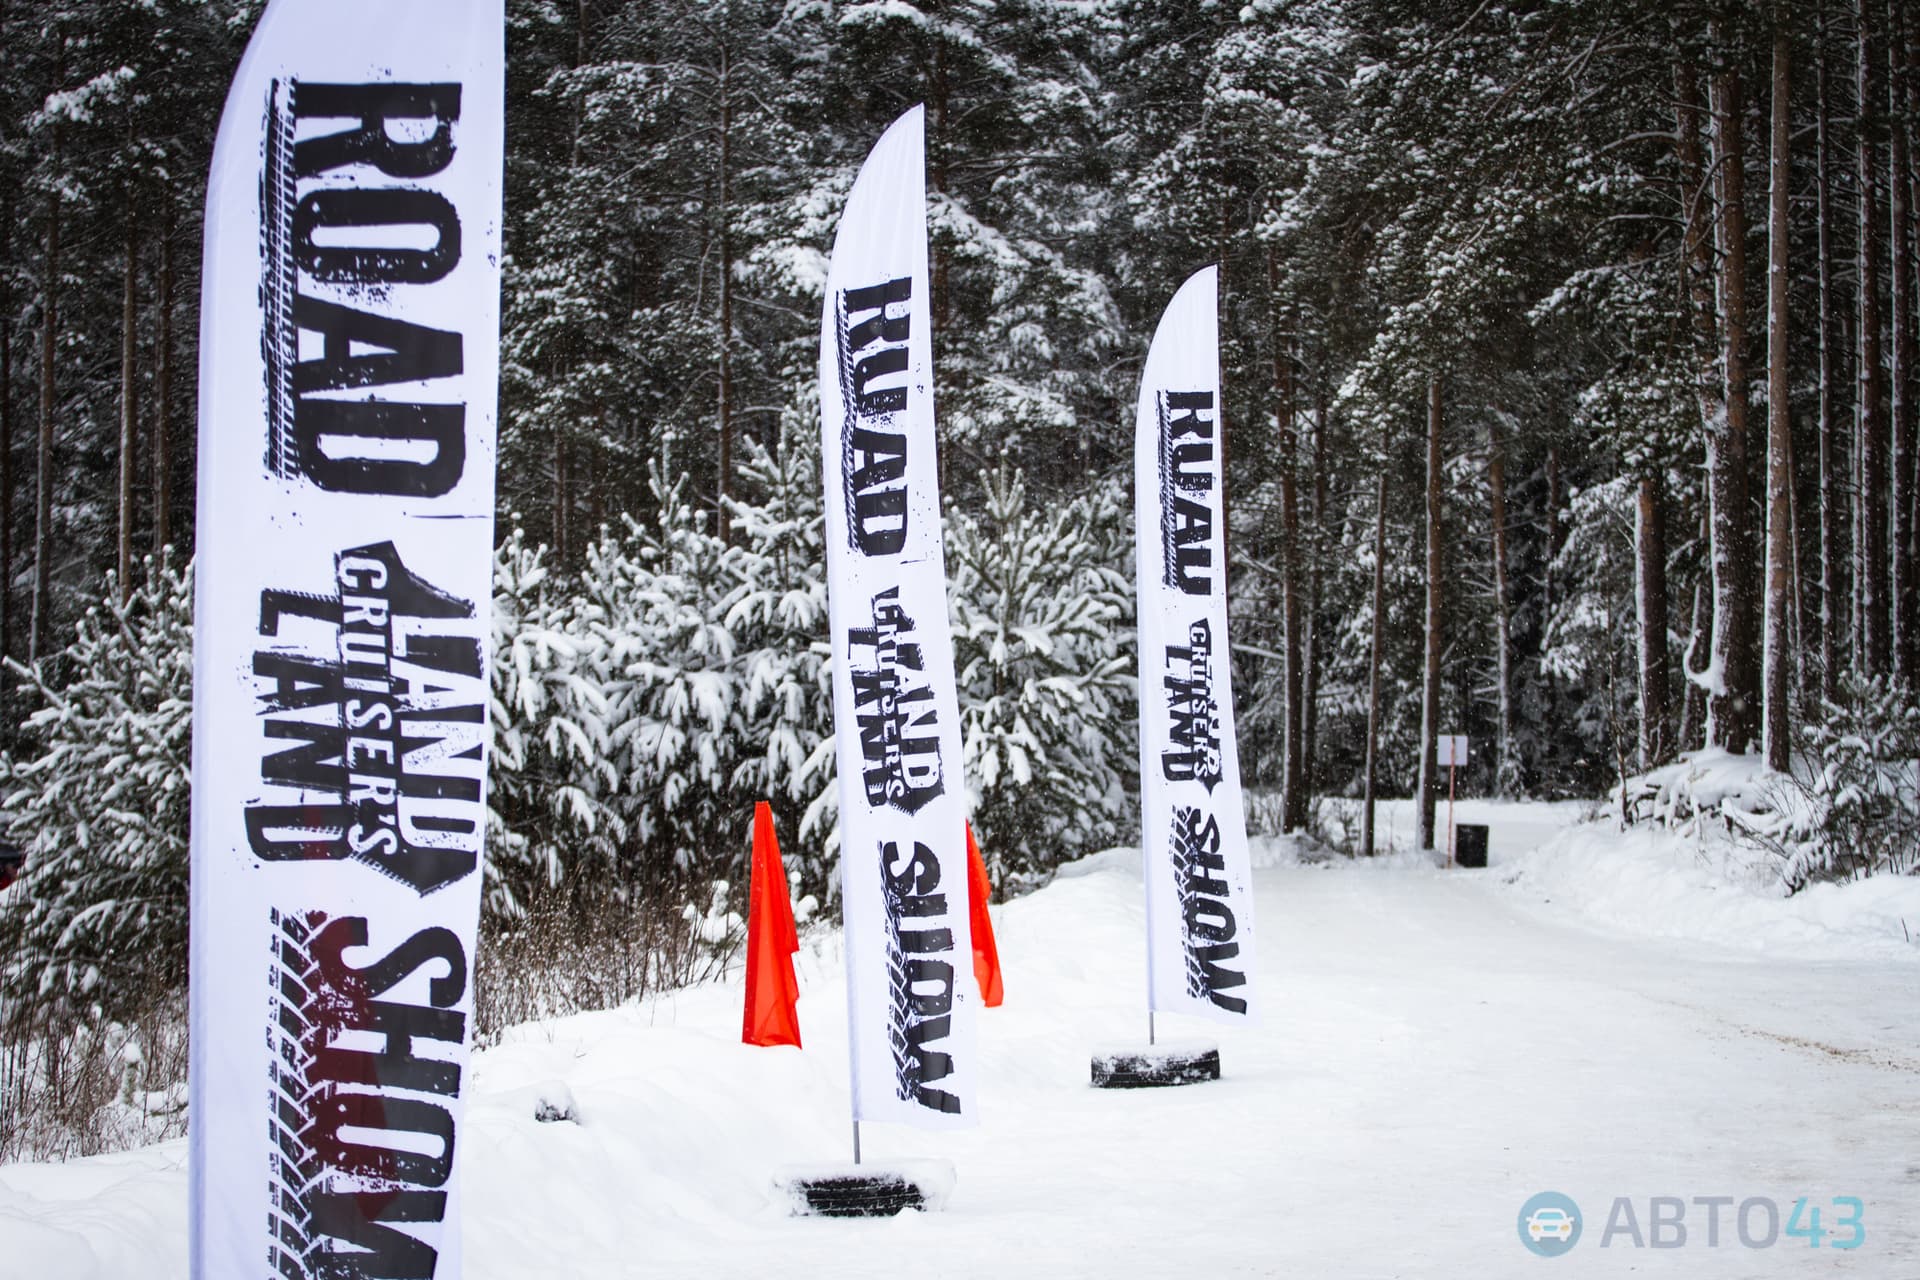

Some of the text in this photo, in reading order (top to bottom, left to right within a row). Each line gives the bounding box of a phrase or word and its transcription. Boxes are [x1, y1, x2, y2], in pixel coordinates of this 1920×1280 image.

[295, 82, 466, 498] ROAD
[244, 589, 352, 861] LAND
[339, 555, 398, 855] CRUISER'S
[389, 614, 484, 852] LAND
[1162, 646, 1196, 781] LAND
[1191, 626, 1208, 778] CRUISER'S
[1184, 808, 1247, 1015] SHOW
